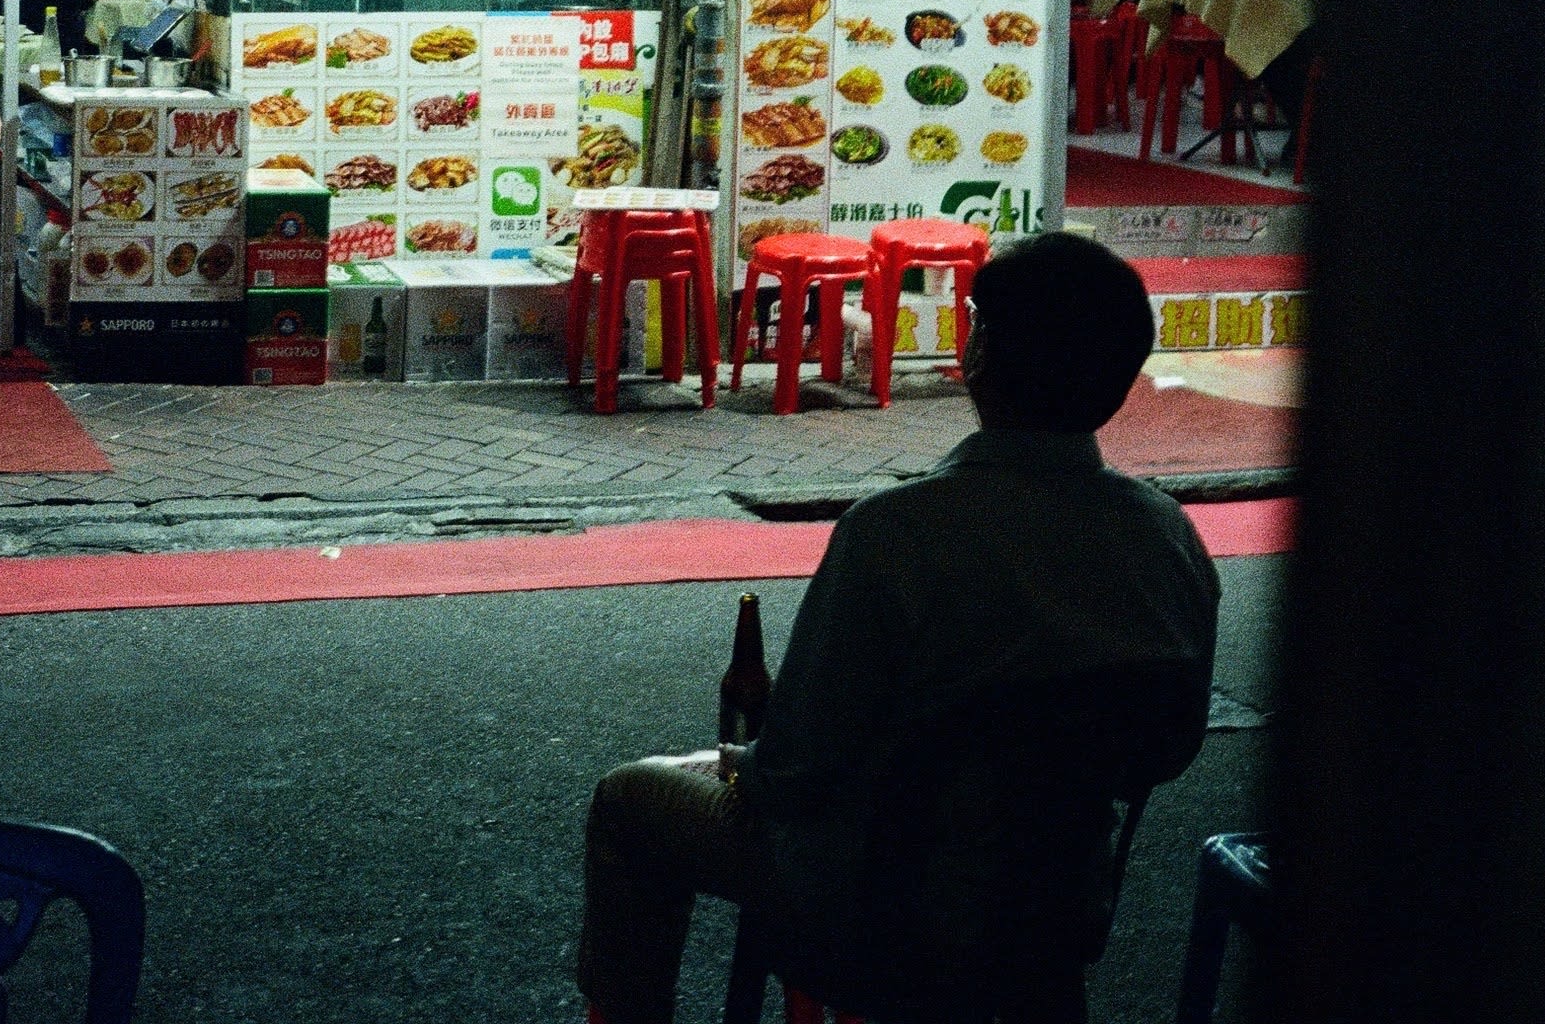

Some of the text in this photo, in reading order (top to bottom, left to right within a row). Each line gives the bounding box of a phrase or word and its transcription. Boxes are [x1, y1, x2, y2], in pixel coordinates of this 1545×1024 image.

[491, 129, 569, 140] Takeaway Area
[490, 218, 541, 232] 微信支付
[257, 248, 323, 261] TSINGTAO
[99, 319, 155, 332] SAPPORO
[256, 346, 320, 359] TSINGTAO
